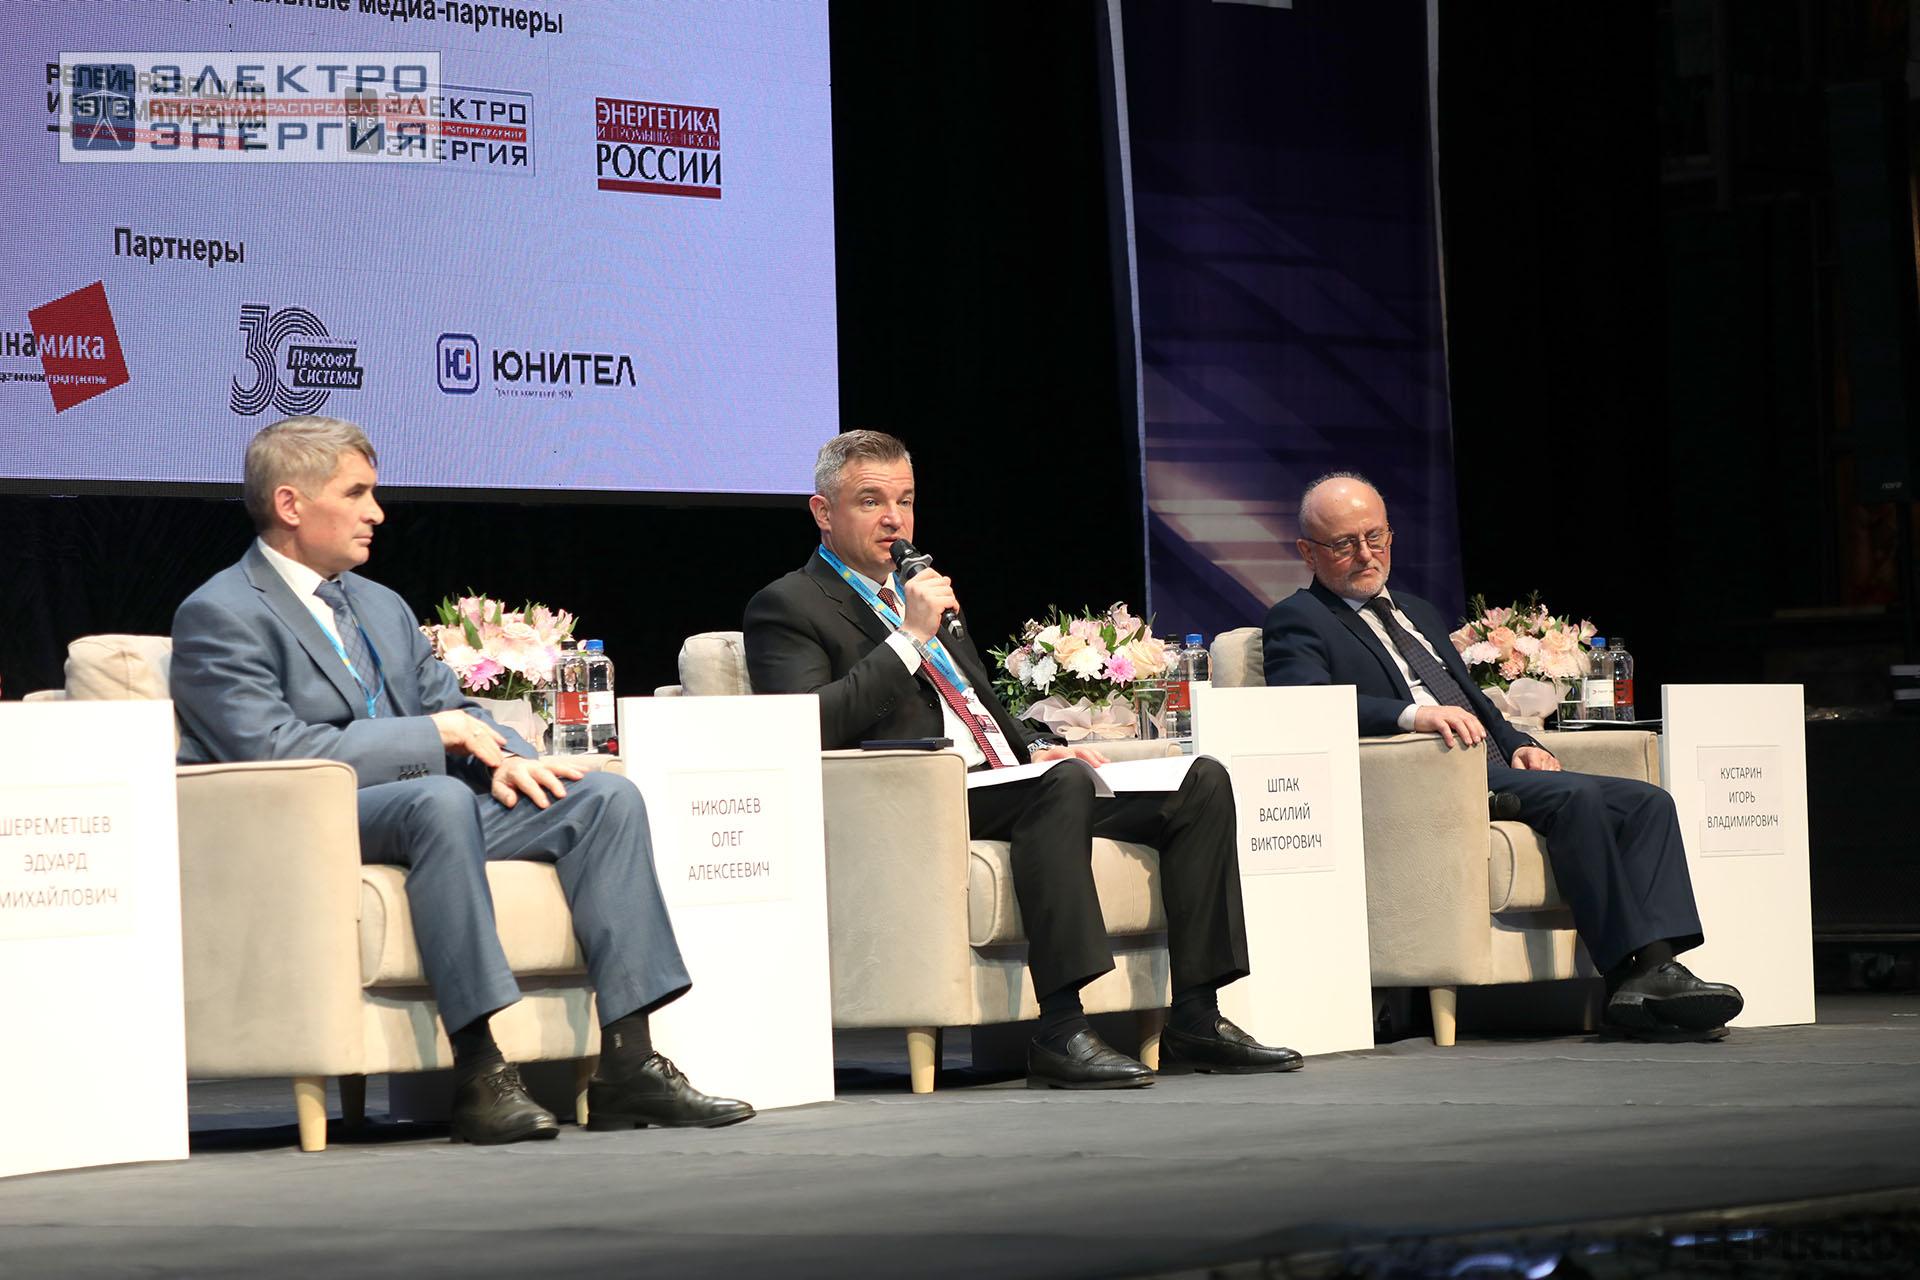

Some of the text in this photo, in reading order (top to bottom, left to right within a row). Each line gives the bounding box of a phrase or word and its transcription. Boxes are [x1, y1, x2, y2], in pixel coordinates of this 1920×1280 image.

[358, 0, 563, 37] медиа-партнеры
[385, 92, 527, 124] ЭЛЕКТРО
[597, 102, 718, 134] ЭНЕРГЕТИКА
[386, 135, 528, 167] ЭНЕРГИЯ
[596, 143, 722, 185] РОССИИ
[114, 228, 245, 268] Партнеры
[0, 332, 106, 360] намика
[492, 350, 637, 387] ЮНИТЕЛ
[1720, 767, 1762, 780] КУСТАРИН
[1267, 777, 1300, 793] ШПАК
[691, 797, 761, 816] НИКОЛАЕВ
[1728, 791, 1756, 804] ИГОРЬ
[1259, 802, 1311, 822] ВАСИЛИЙ
[1707, 814, 1779, 830] ВЛАДИМИРОВИЧ
[0, 816, 112, 836] ШЕРЕМЕТЦЕВ
[711, 830, 744, 848] ОЛЕГ
[1250, 834, 1322, 852] ВИКТОРОВИЧ
[23, 852, 88, 875] ЭДУАРД
[688, 861, 770, 881] АЛЕКСЕЕВИЧ
